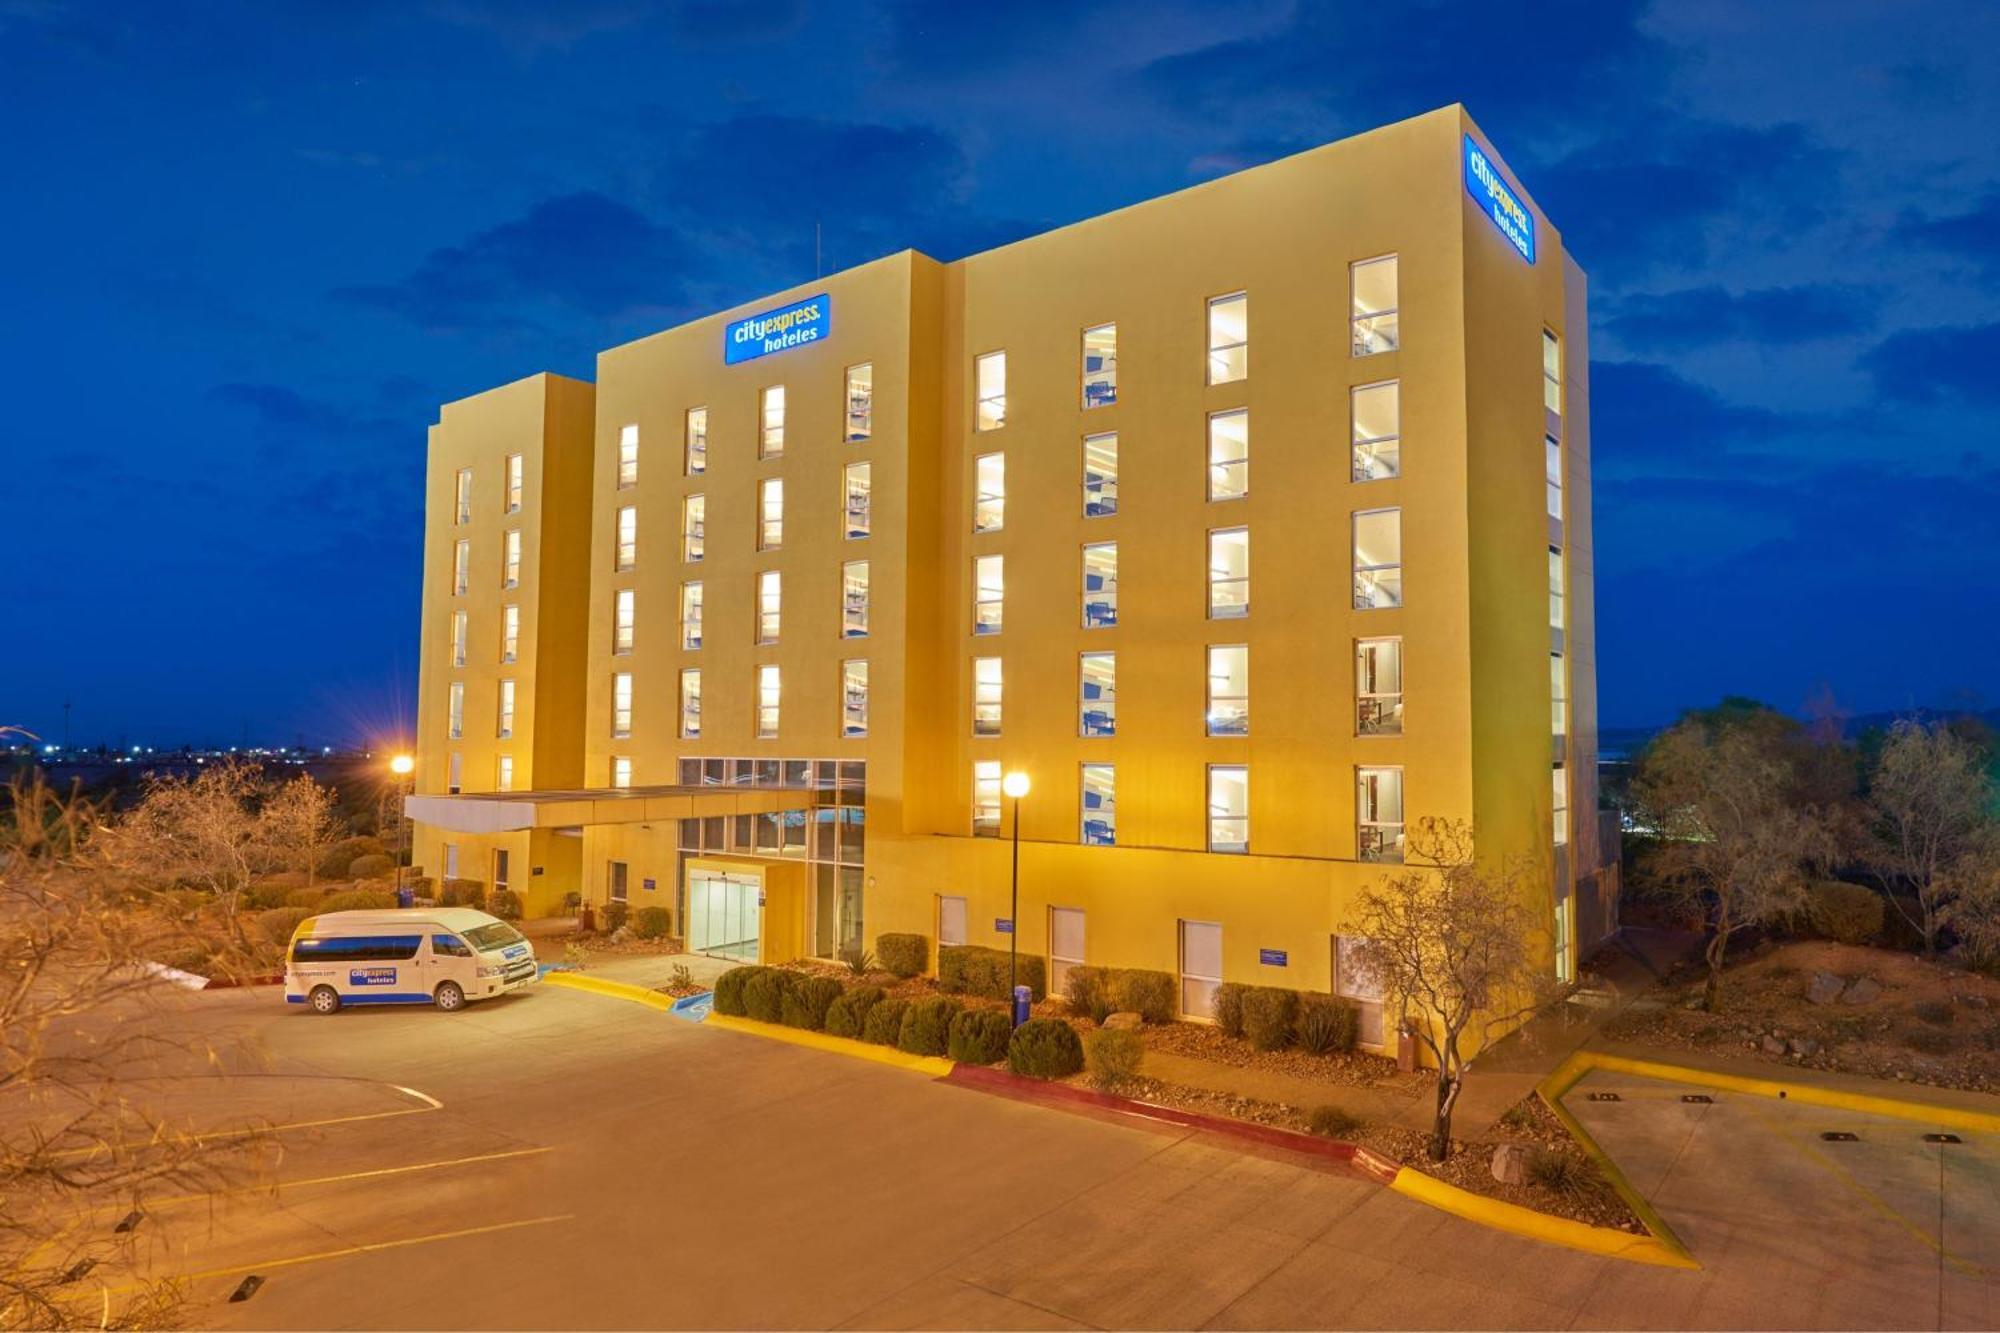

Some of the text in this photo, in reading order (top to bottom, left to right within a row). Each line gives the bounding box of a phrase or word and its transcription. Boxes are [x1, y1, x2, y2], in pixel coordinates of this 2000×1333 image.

[1494, 203, 1528, 256] hoteles
[764, 327, 818, 353] hoteles
[367, 976, 394, 984] hoteles
